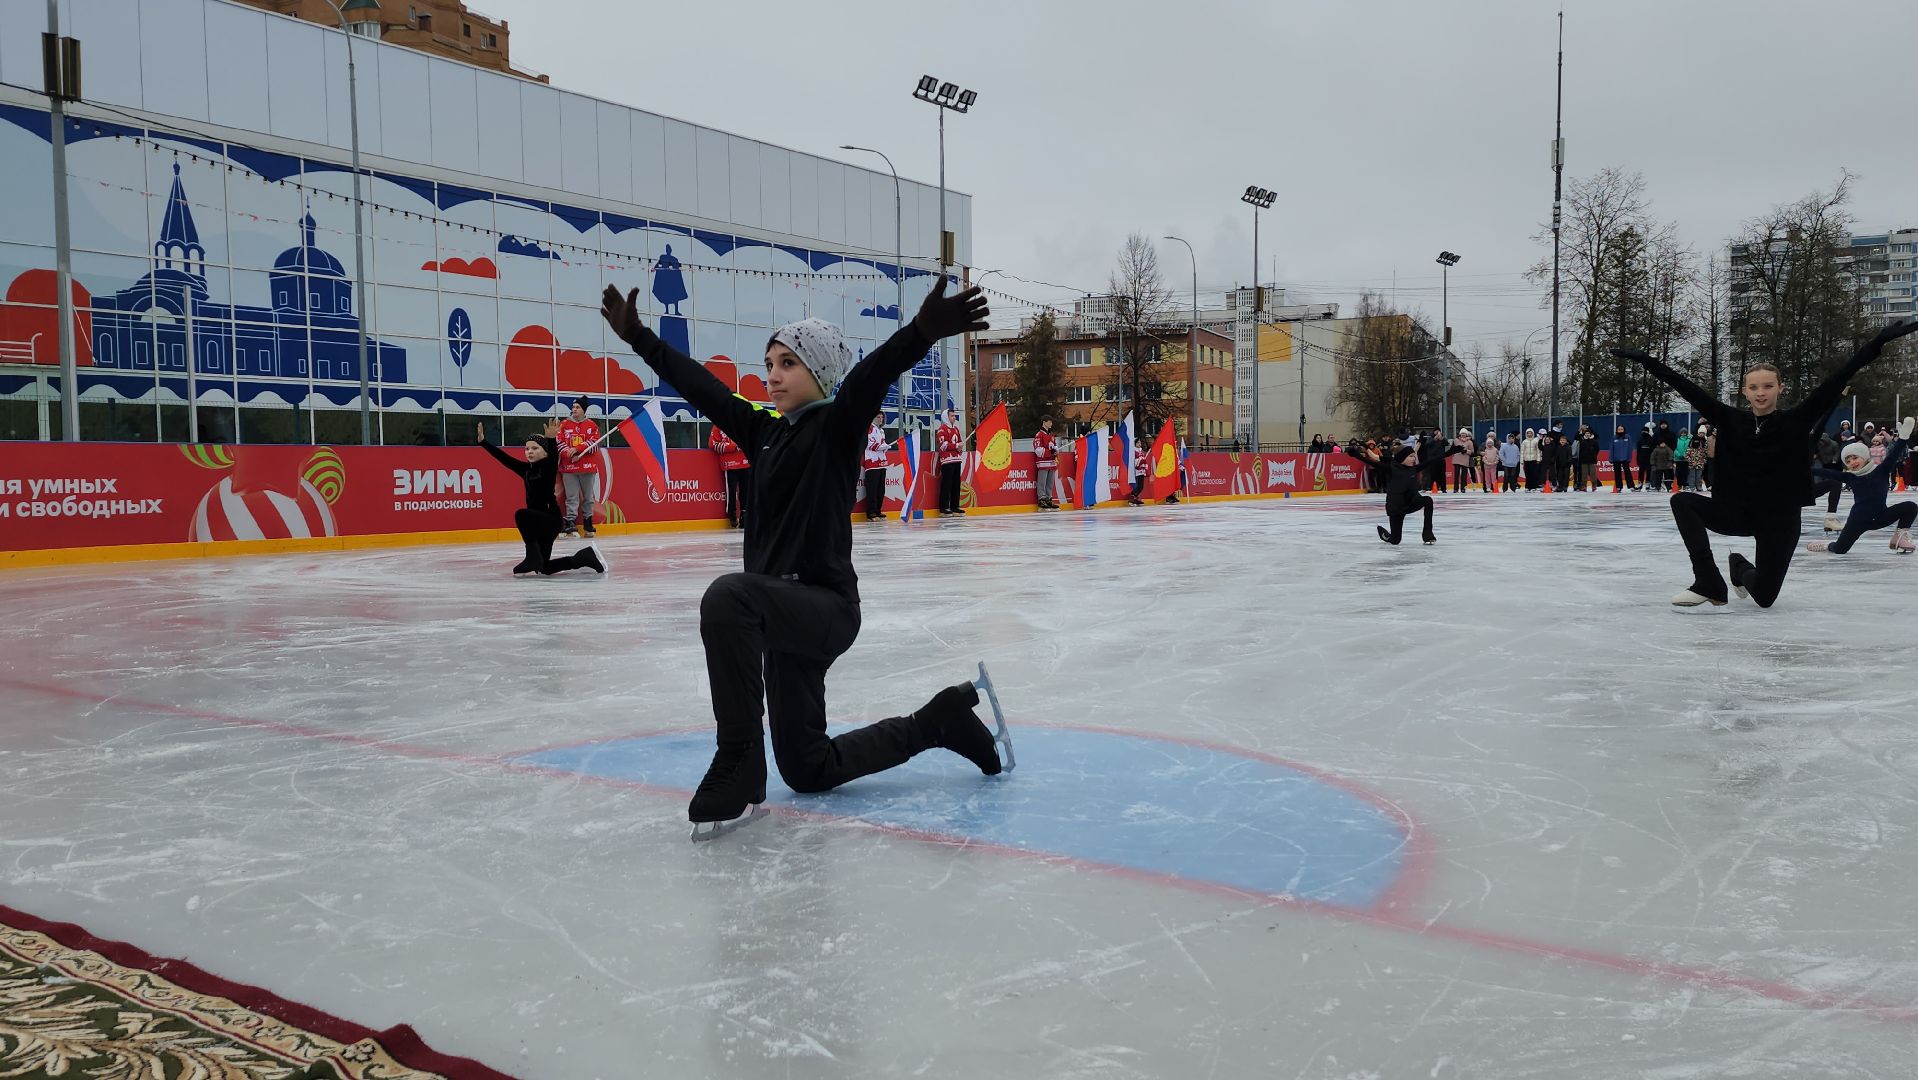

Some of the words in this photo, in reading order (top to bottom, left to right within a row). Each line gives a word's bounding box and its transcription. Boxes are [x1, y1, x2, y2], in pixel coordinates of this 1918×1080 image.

[393, 468, 483, 496] ЗИМА
[667, 479, 699, 490] ПАРКИ
[885, 478, 900, 486] анк
[28, 478, 118, 500] умных
[667, 491, 727, 502] ПОДМОСКОВ
[16, 495, 163, 519] свободных
[394, 501, 402, 511] В
[404, 499, 484, 512] ПОДМОСКОВЬЕ
